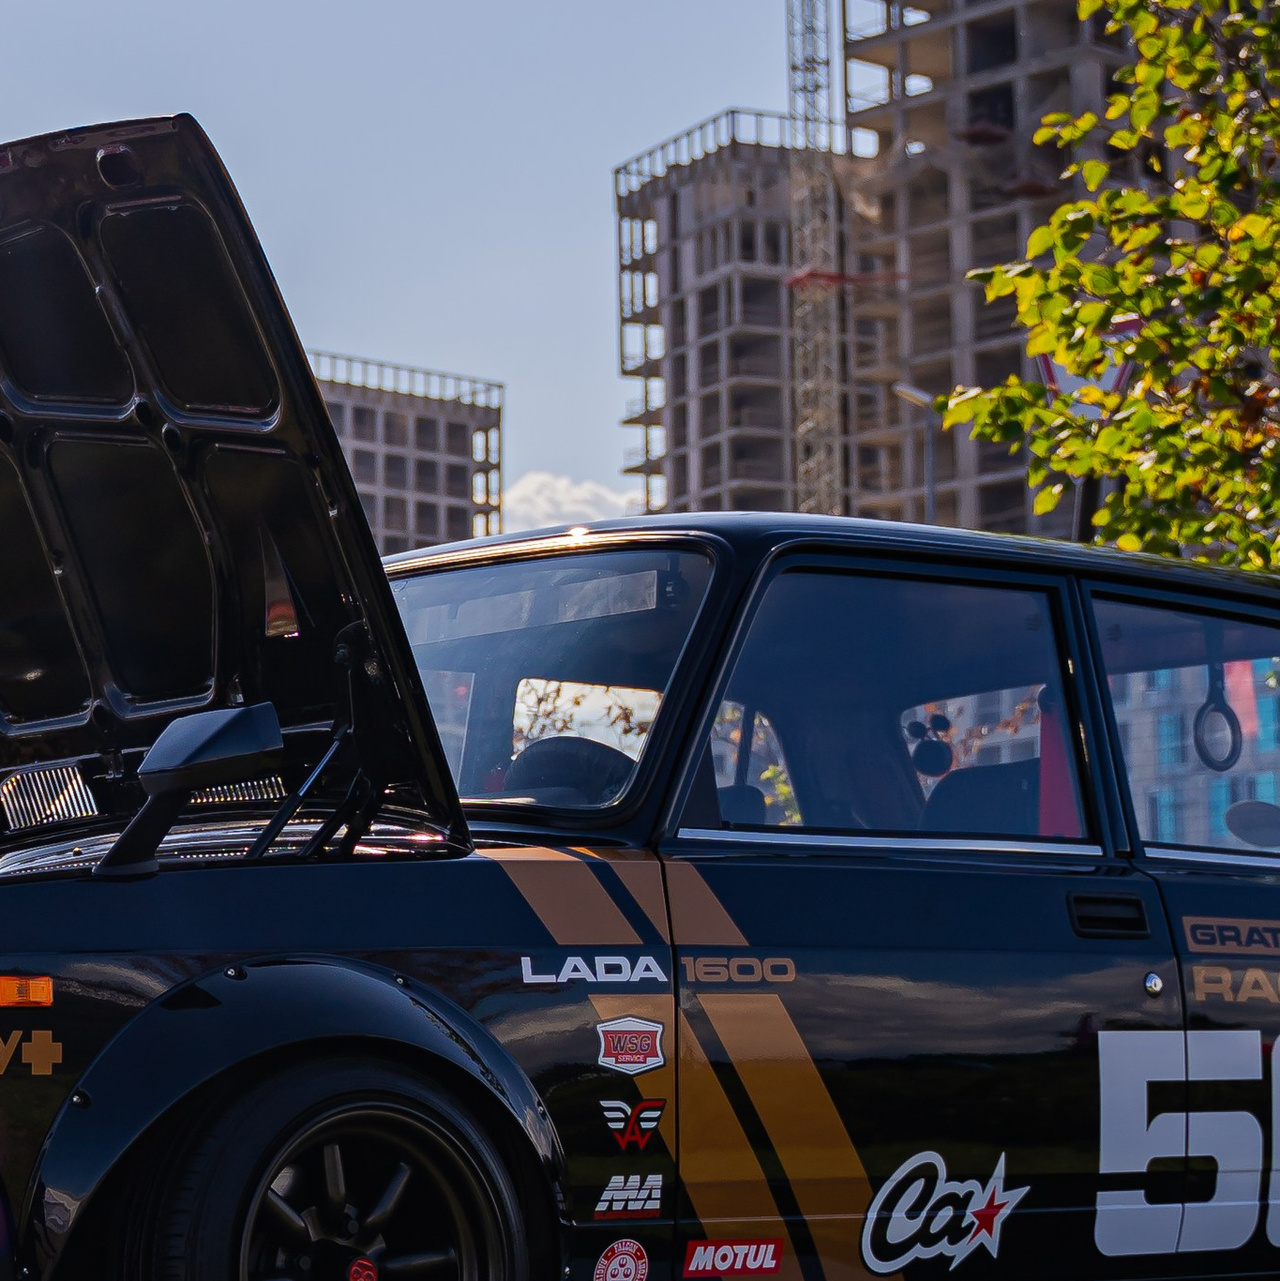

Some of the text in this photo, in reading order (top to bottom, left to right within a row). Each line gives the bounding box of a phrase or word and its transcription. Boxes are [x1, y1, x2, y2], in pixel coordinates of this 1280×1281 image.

[521, 956, 796, 983] LADA 1600
[1192, 965, 1280, 1004] RA
[609, 1033, 652, 1054] WSG
[617, 1054, 645, 1063] SERVICE
[1094, 1030, 1280, 1257] 5
[613, 1241, 639, 1254] FALCON
[688, 1244, 776, 1271] MOTUL
